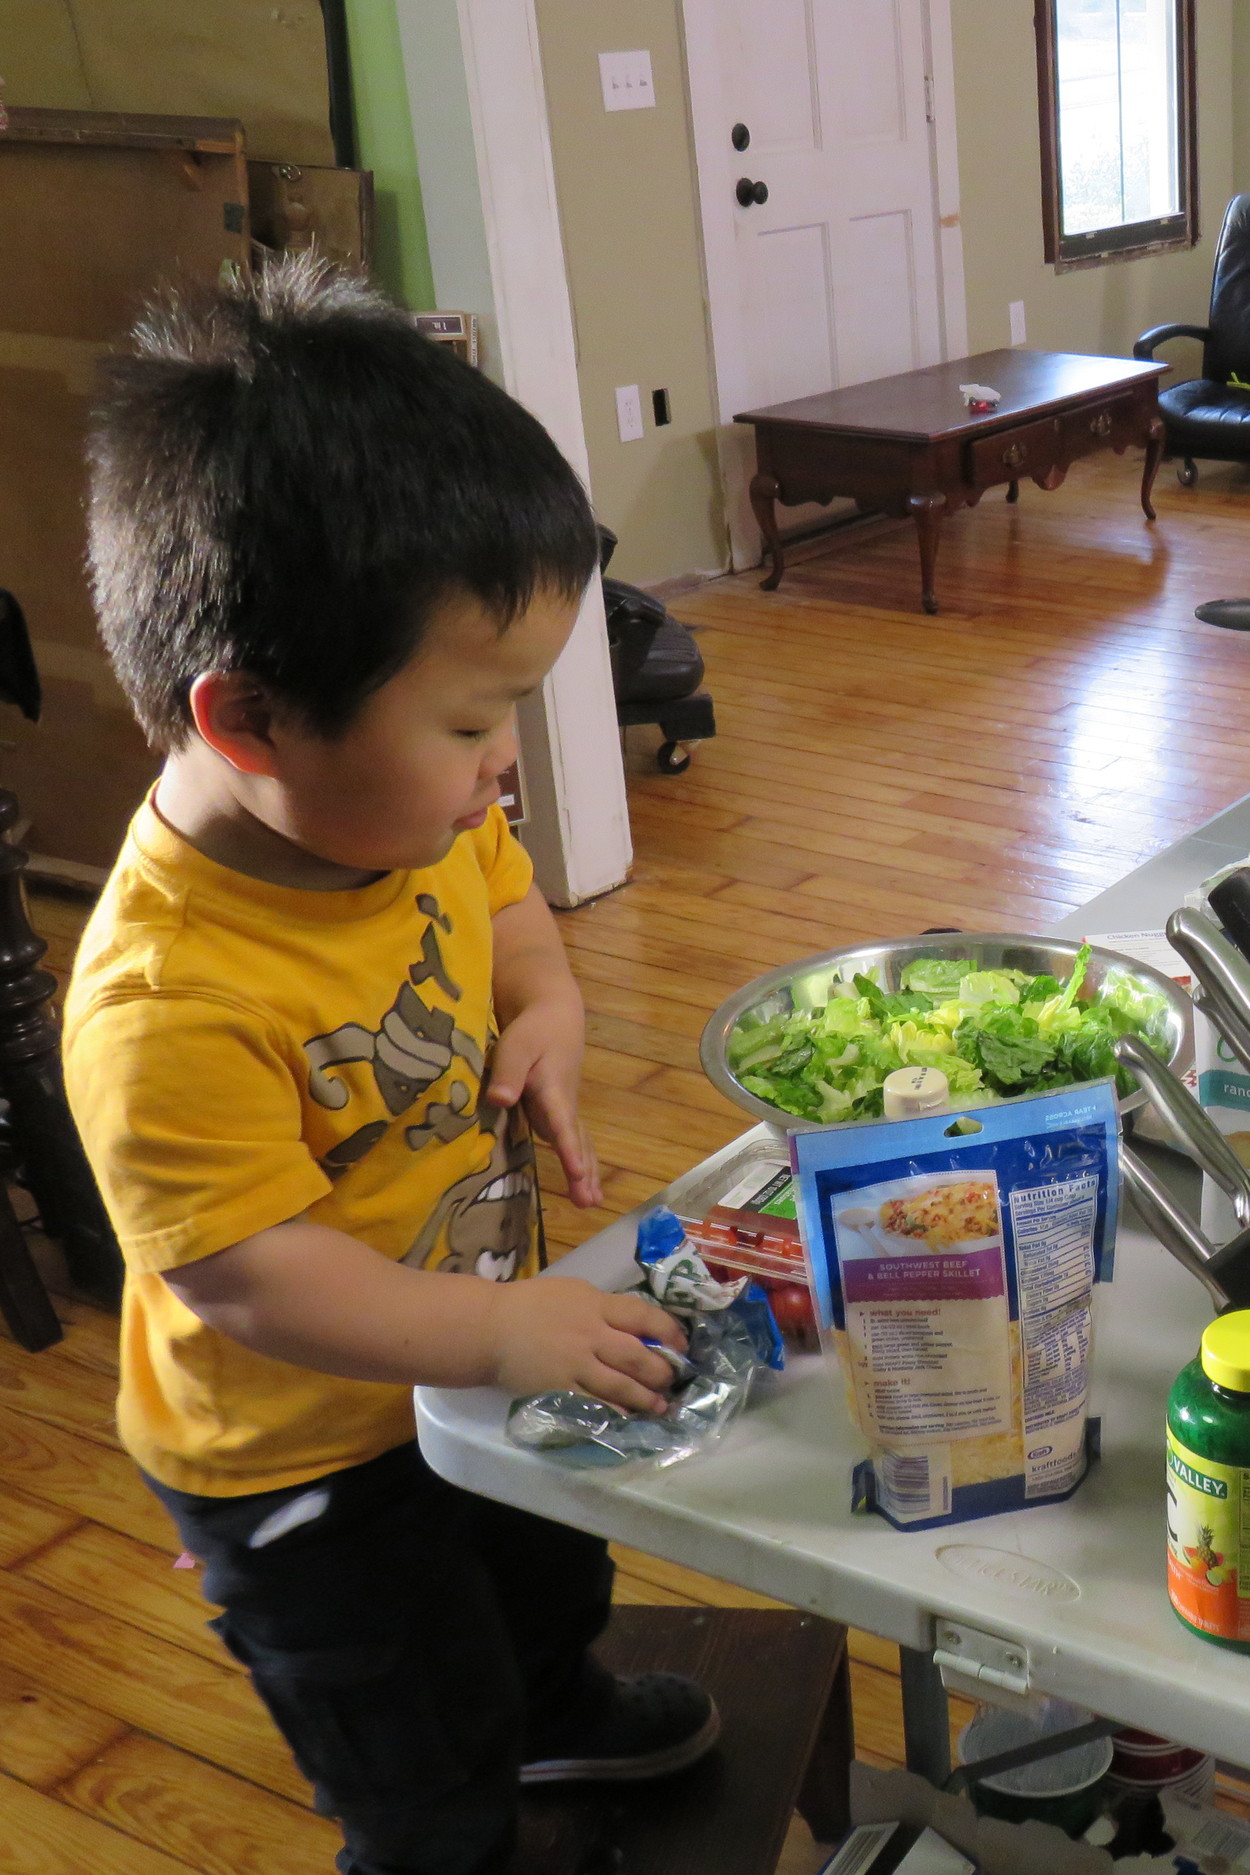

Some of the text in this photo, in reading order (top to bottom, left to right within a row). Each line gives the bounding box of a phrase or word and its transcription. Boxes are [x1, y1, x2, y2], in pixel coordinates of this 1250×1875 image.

[1013, 1180, 1096, 1203] Nutrition Facts
[880, 1260, 968, 1271] SOUTHWEST BEEF
[877, 1271, 900, 1280] BELL
[903, 1270, 940, 1279] PEPPER
[942, 1268, 981, 1278] SKILLET
[895, 1309, 913, 1318] you
[914, 1308, 941, 1316] need!
[873, 1377, 911, 1387] make it!
[1173, 1455, 1223, 1496] VALLEY
